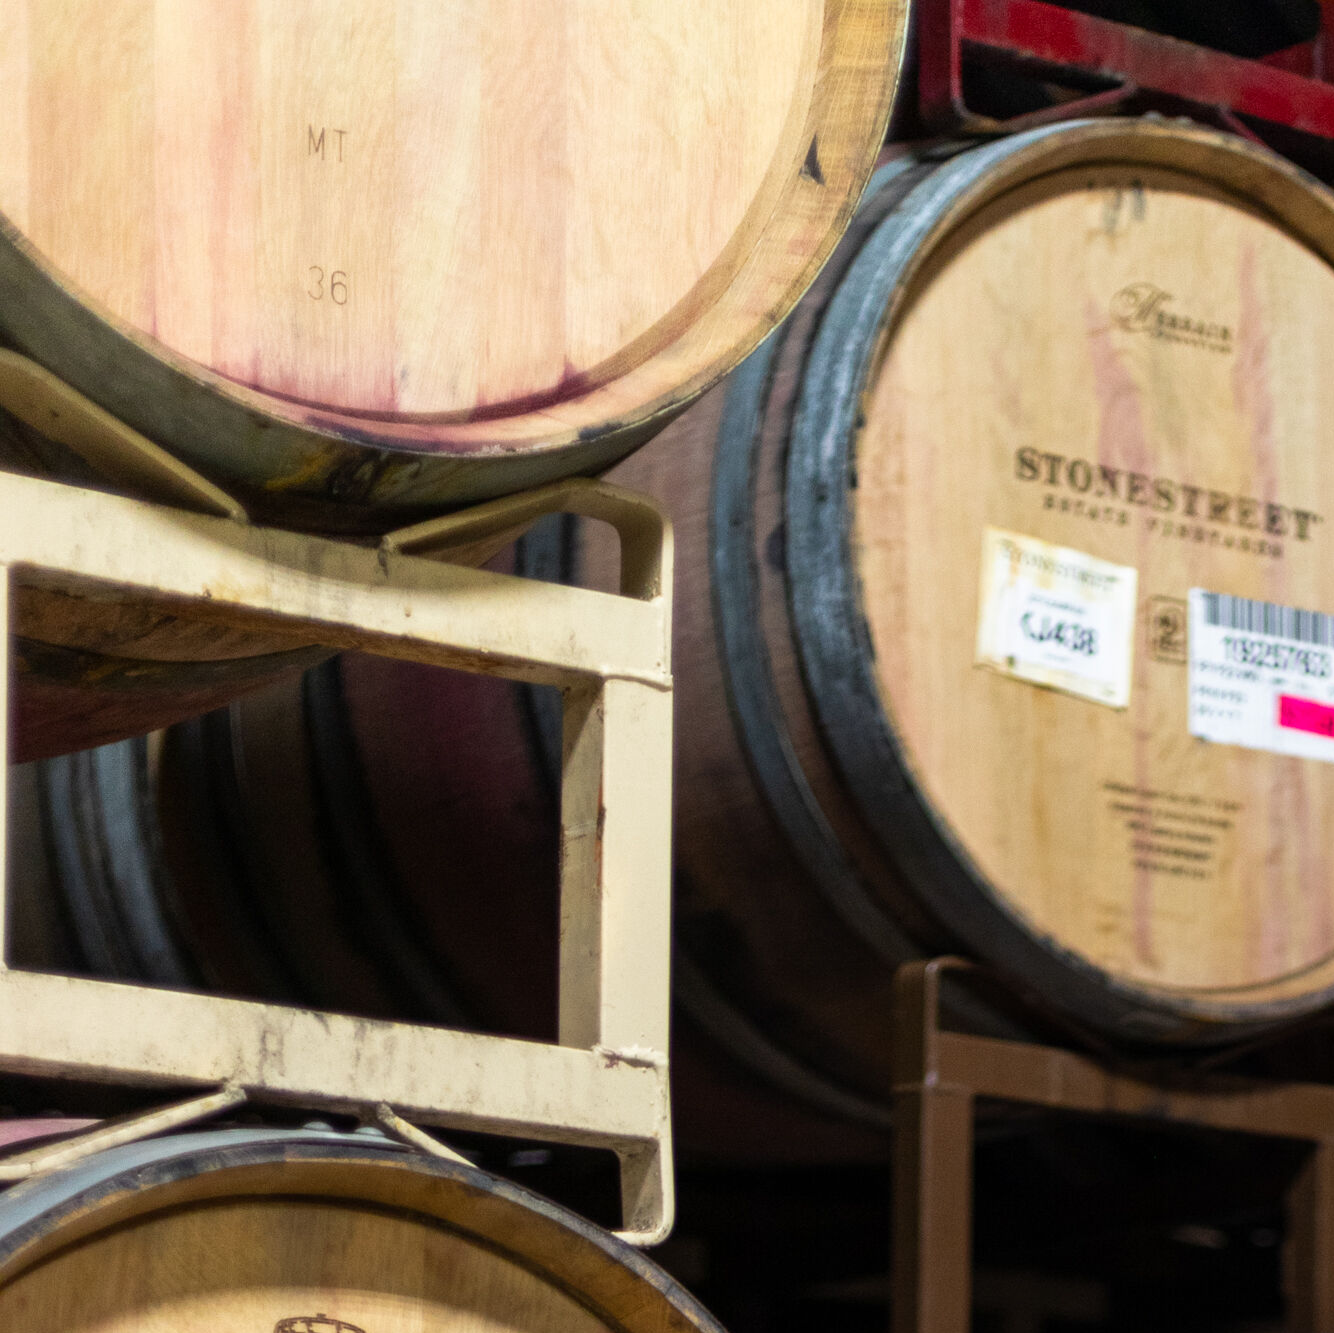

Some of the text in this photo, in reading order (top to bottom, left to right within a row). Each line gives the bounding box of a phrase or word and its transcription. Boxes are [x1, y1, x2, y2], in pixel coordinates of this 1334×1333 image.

[307, 124, 349, 163] MT
[307, 265, 348, 306] 36
[1014, 446, 1316, 541] STONESTREET
